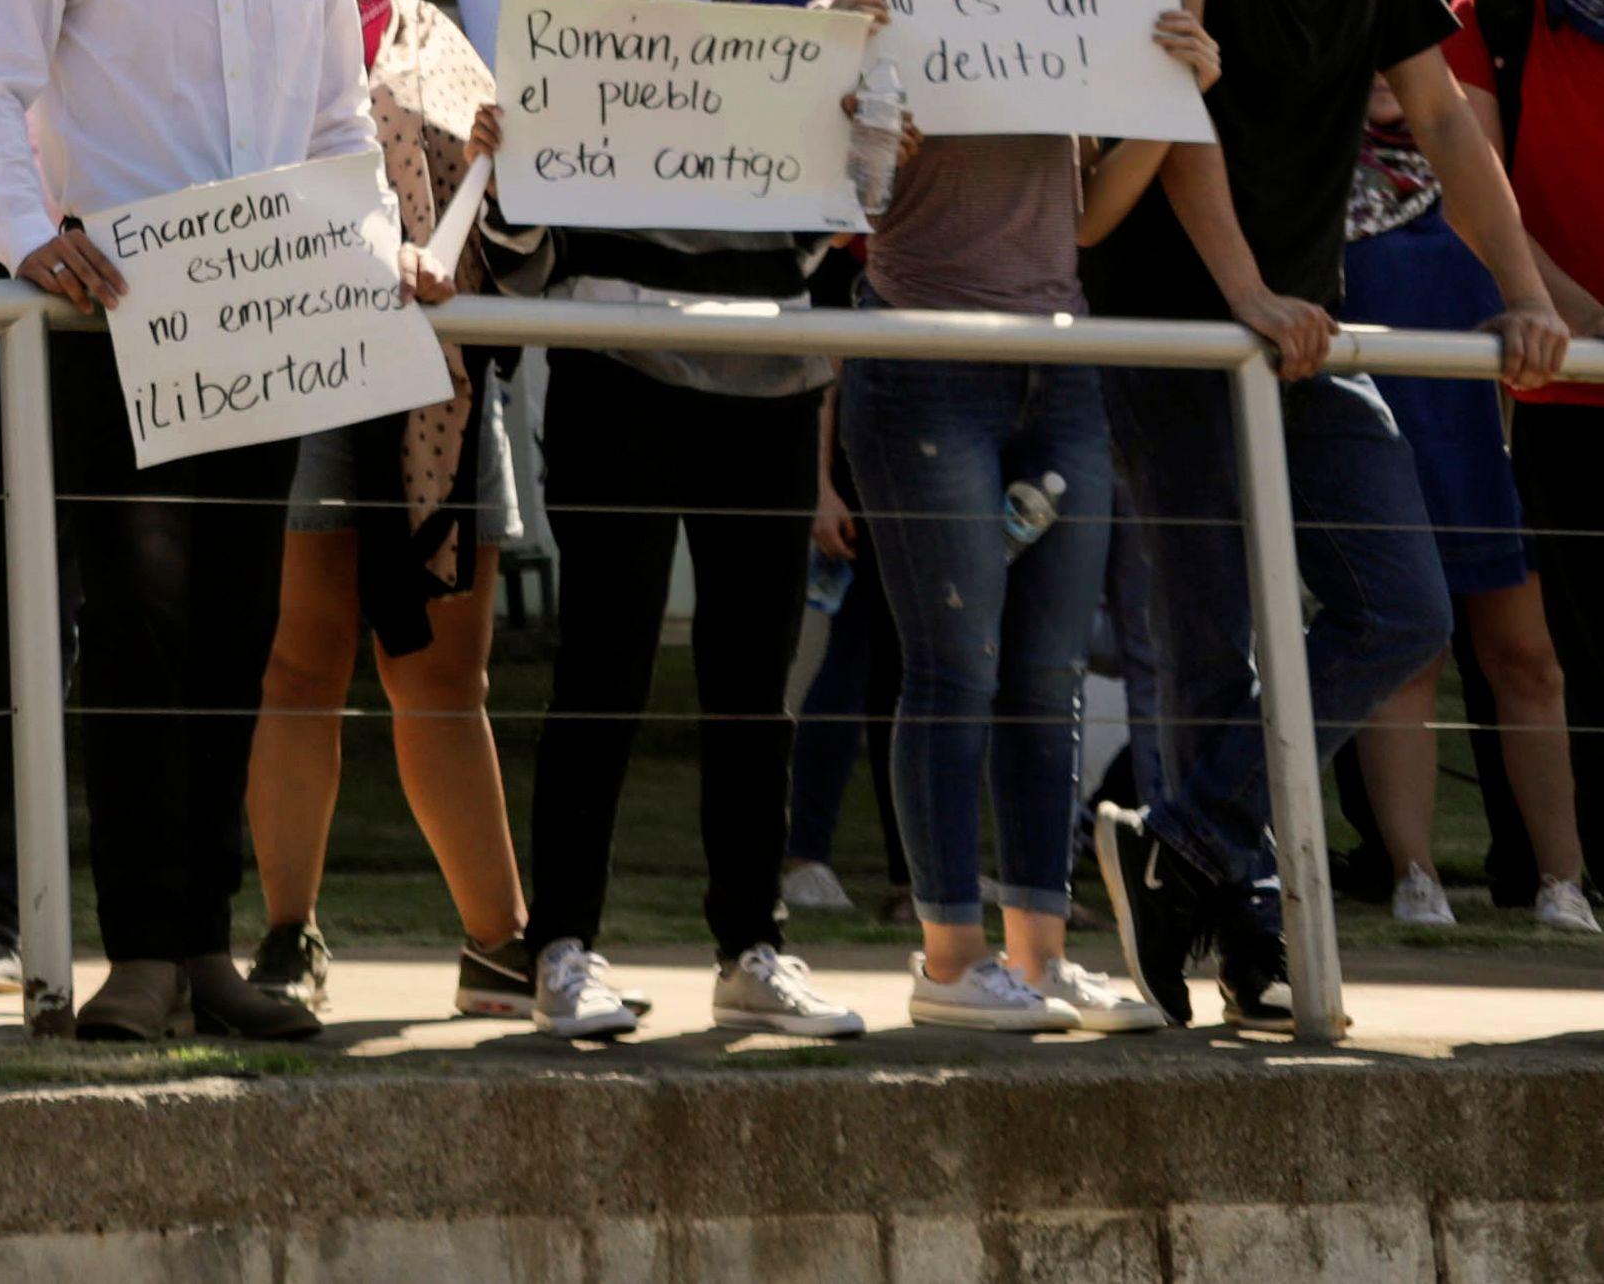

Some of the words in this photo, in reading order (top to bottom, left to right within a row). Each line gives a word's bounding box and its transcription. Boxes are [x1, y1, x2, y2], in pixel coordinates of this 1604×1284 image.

[527, 8, 680, 71] Román,
[691, 33, 822, 83] amigo
[924, 33, 1090, 87] delito!
[518, 76, 549, 113] el
[597, 80, 724, 126] pueblo
[534, 136, 617, 182] está
[654, 144, 803, 199] contigo
[111, 191, 291, 259] Encarcelan
[148, 310, 188, 346] no
[218, 281, 406, 336] empresarios
